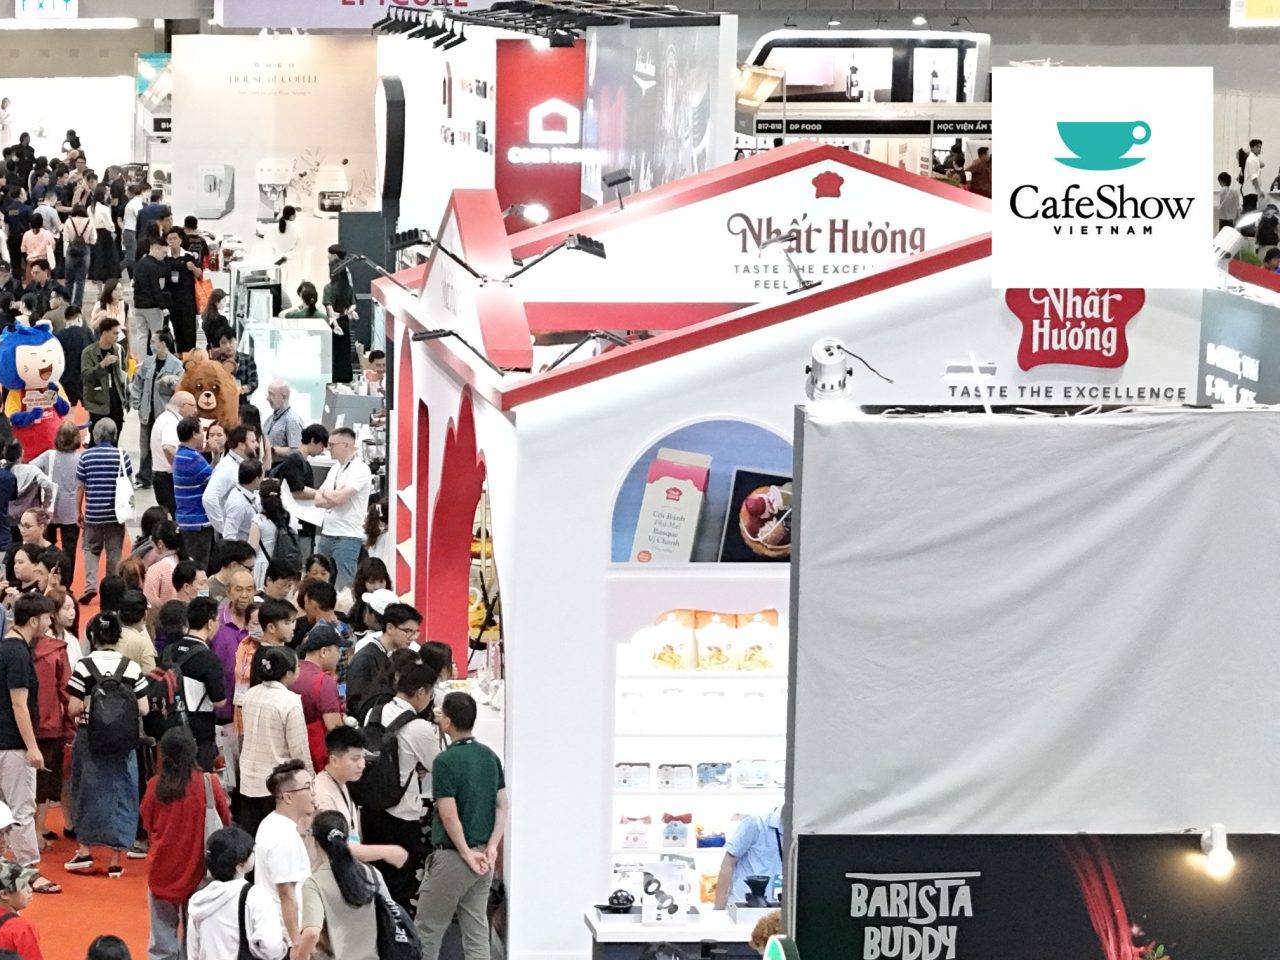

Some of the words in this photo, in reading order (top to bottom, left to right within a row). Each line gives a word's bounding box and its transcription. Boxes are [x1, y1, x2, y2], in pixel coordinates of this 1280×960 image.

[800, 123, 823, 131] FOOD
[936, 122, 955, 132] HỌC
[726, 212, 822, 254] Nhất
[828, 219, 926, 257] Hương
[733, 264, 780, 274] TASTE
[788, 264, 815, 274] THE
[753, 280, 789, 289] FEEL
[1028, 287, 1123, 323] Nhất
[1032, 319, 1117, 356] Hương
[948, 385, 1009, 399] TASTE
[1017, 385, 1054, 399] THE
[1063, 385, 1187, 400] EXCELLENCE
[850, 879, 973, 925] BARISTA
[863, 925, 958, 960] BUDDY
